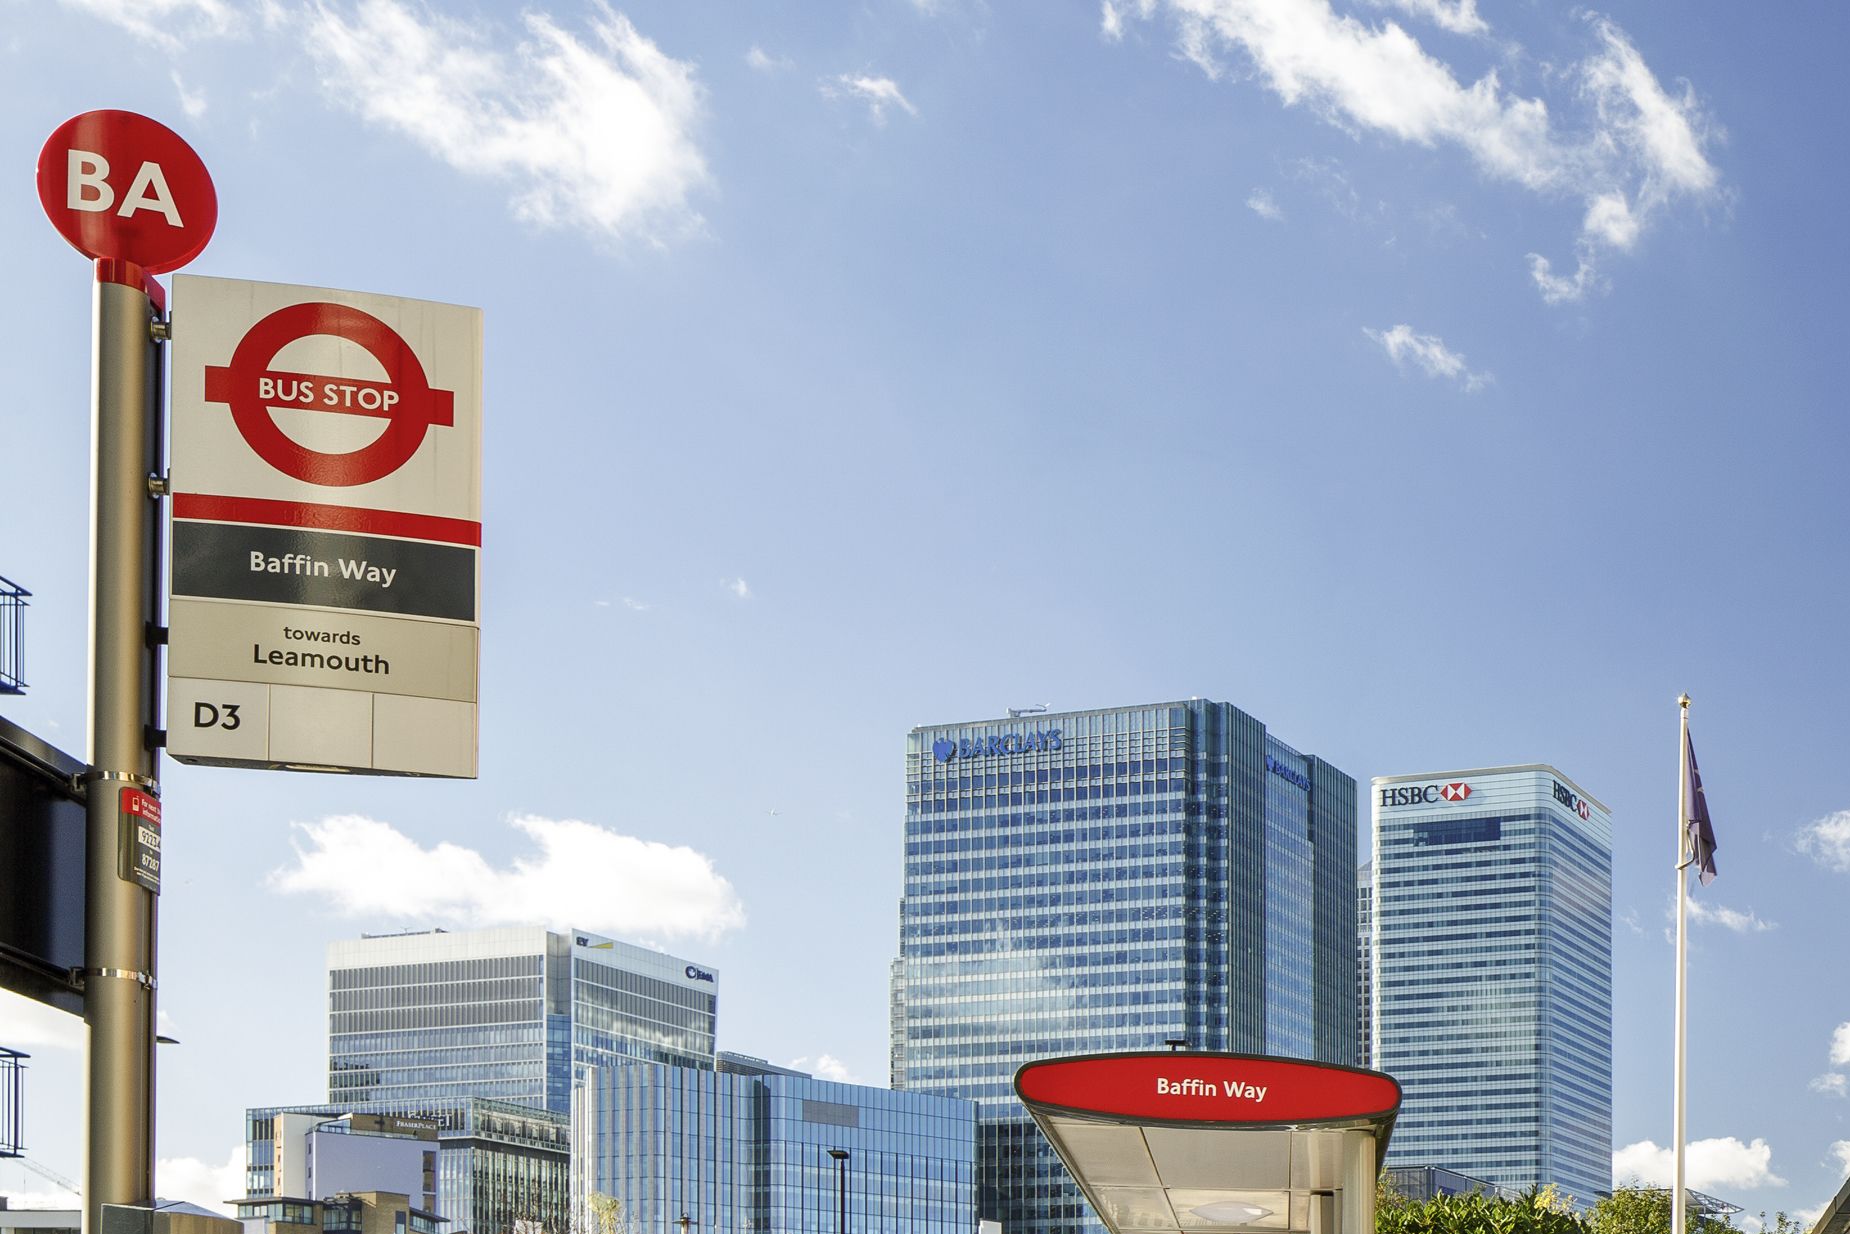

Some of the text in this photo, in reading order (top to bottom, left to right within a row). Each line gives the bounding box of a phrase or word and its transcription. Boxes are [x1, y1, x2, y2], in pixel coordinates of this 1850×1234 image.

[67, 148, 184, 228] BA
[259, 377, 399, 411] BUS STOP
[250, 551, 397, 588] Baffin Way
[283, 626, 361, 645] towards
[253, 644, 390, 674] Leamouth
[194, 701, 241, 730] D3
[959, 728, 1062, 759] BARCLAYS
[1380, 784, 1438, 807] HSBC
[1552, 779, 1577, 812] HSBC
[1157, 1078, 1268, 1102] Baffin Way
